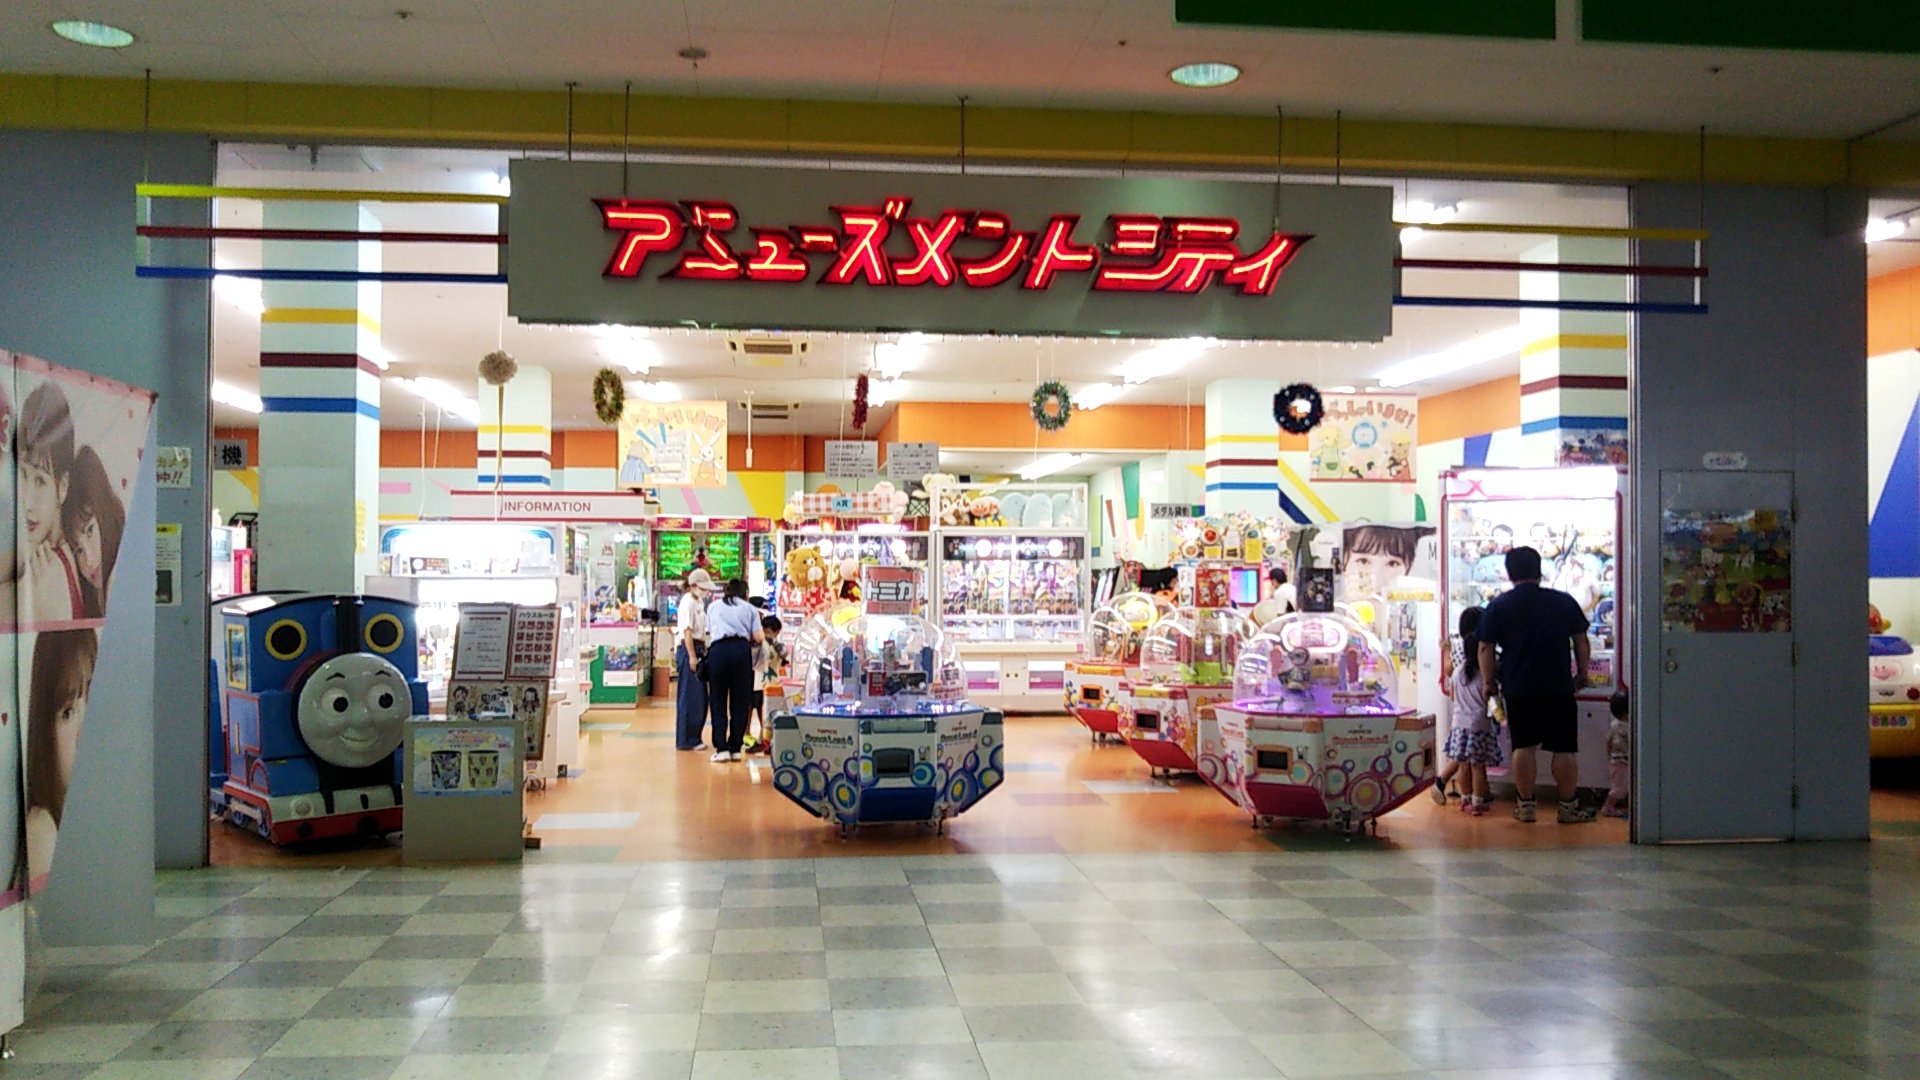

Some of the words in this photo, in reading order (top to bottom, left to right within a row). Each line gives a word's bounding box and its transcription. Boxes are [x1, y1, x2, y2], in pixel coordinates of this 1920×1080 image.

[591, 197, 1315, 295] アミューズメントシティ
[504, 501, 592, 512] INFORMATION
[866, 580, 913, 601] トミカ
